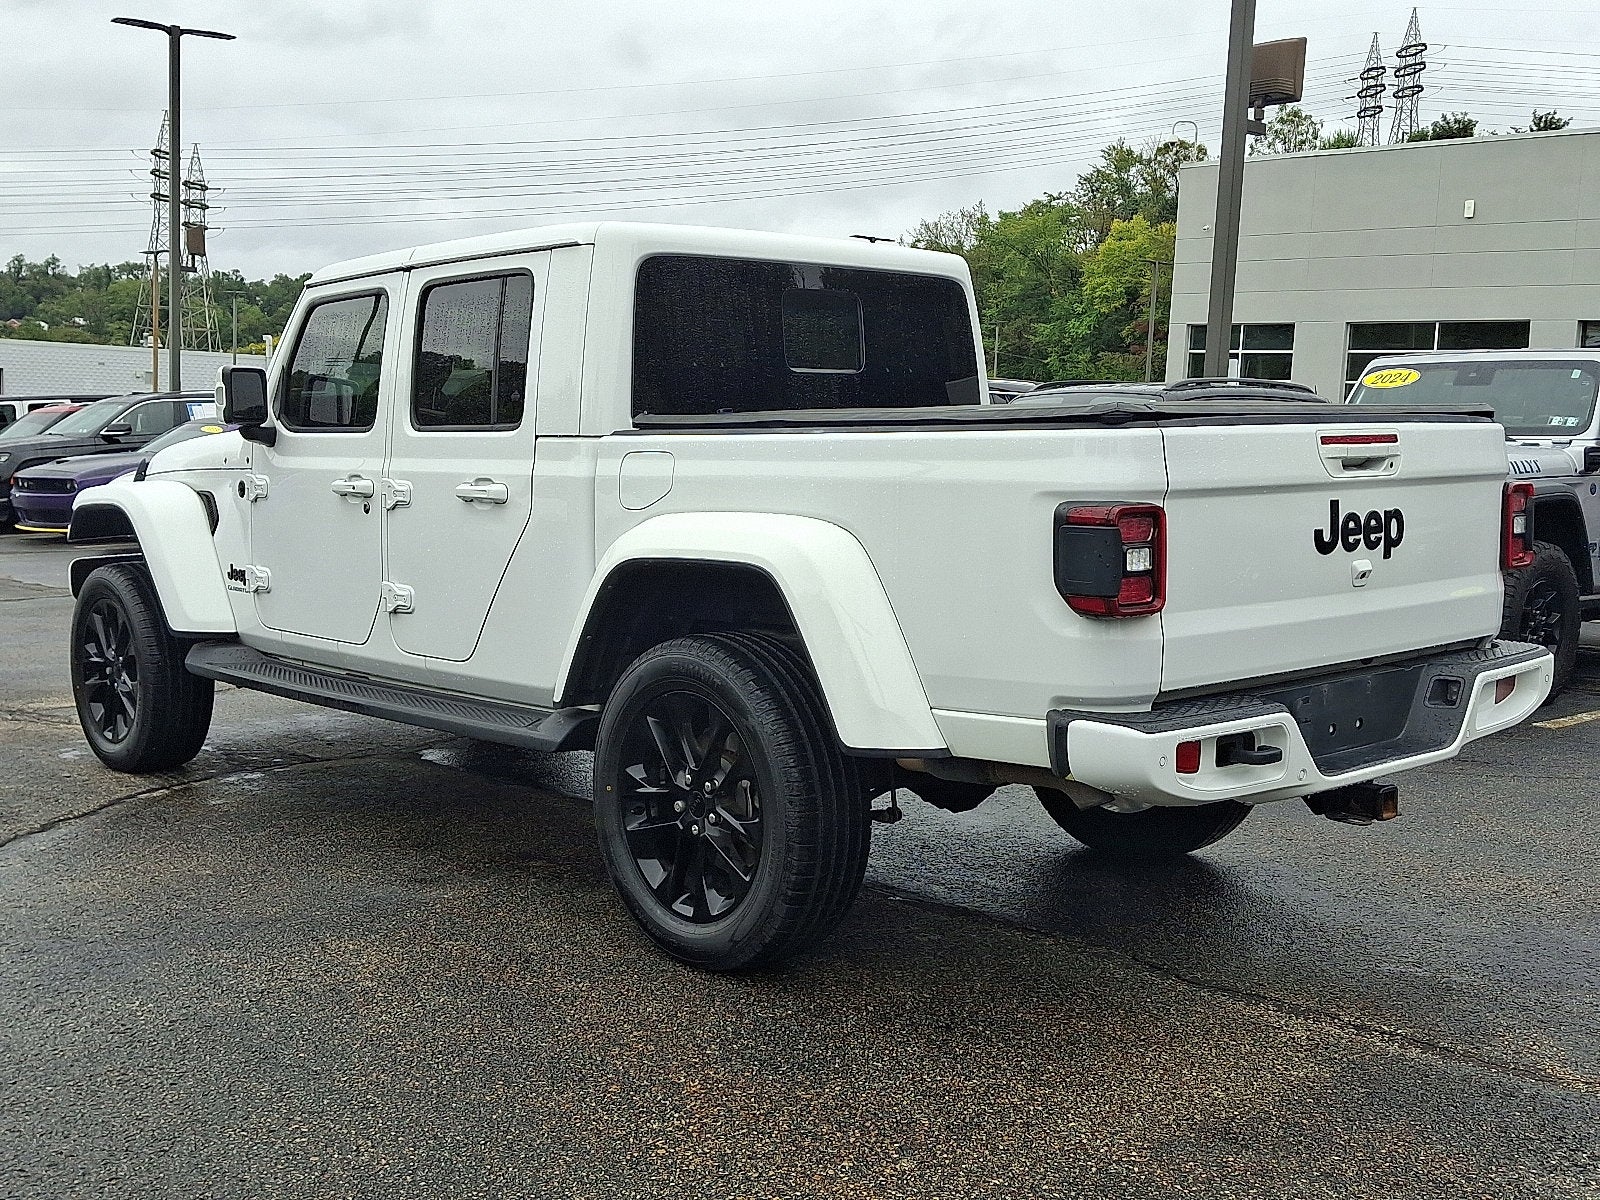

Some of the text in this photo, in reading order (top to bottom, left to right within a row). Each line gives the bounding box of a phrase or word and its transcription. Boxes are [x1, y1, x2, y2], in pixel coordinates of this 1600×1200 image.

[1370, 371, 1412, 385] 2024
[1509, 459, 1541, 475] ILLYS
[1313, 499, 1405, 560] Jeep
